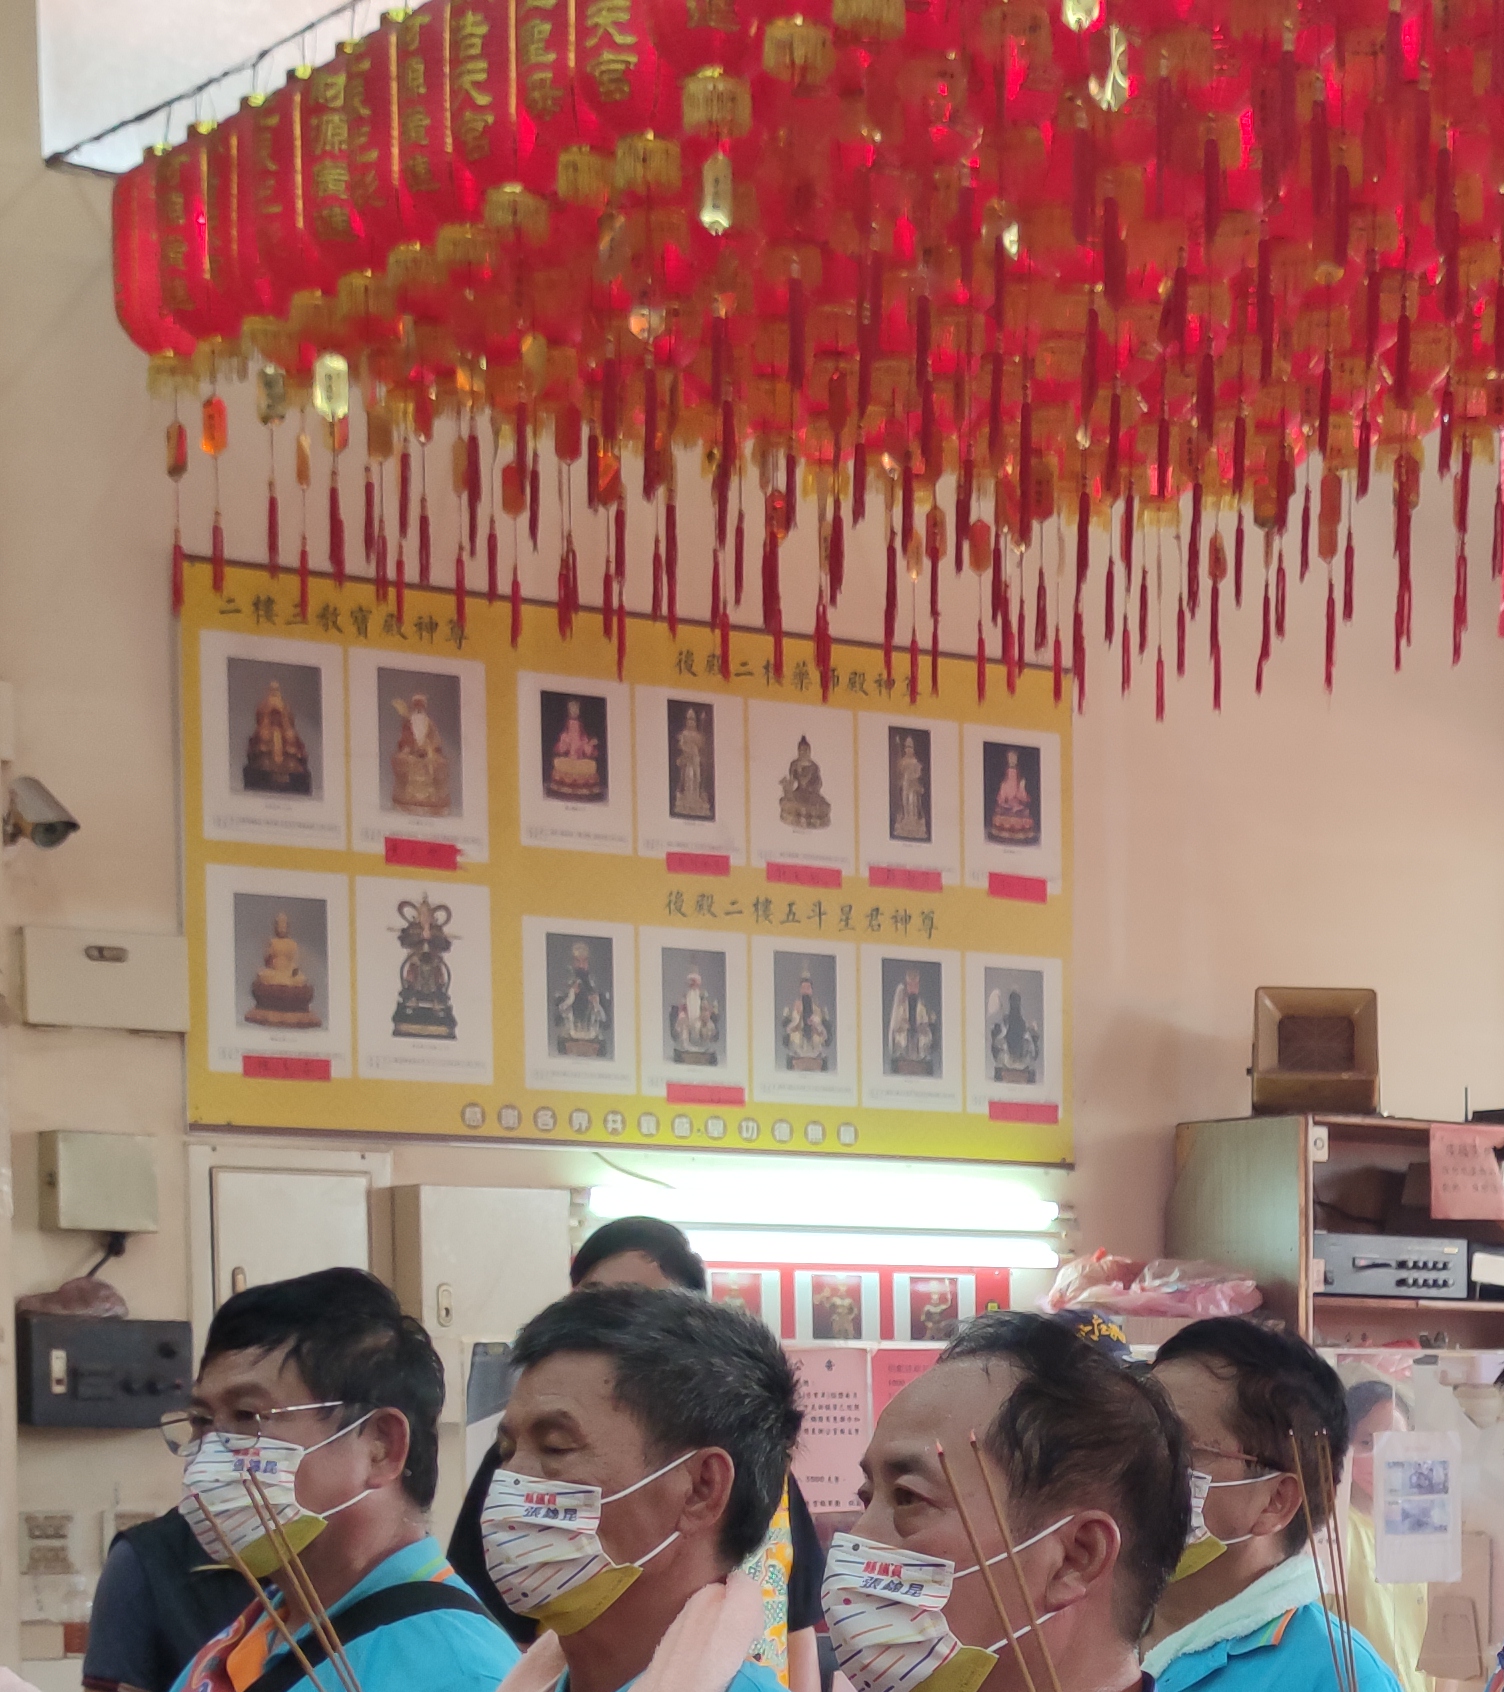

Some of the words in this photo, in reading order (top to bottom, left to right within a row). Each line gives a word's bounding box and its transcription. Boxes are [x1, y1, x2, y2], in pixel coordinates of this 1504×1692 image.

[664, 888, 940, 940] 後殿二樓五斗星君神尊
[859, 1576, 925, 1598] 張錦昆
